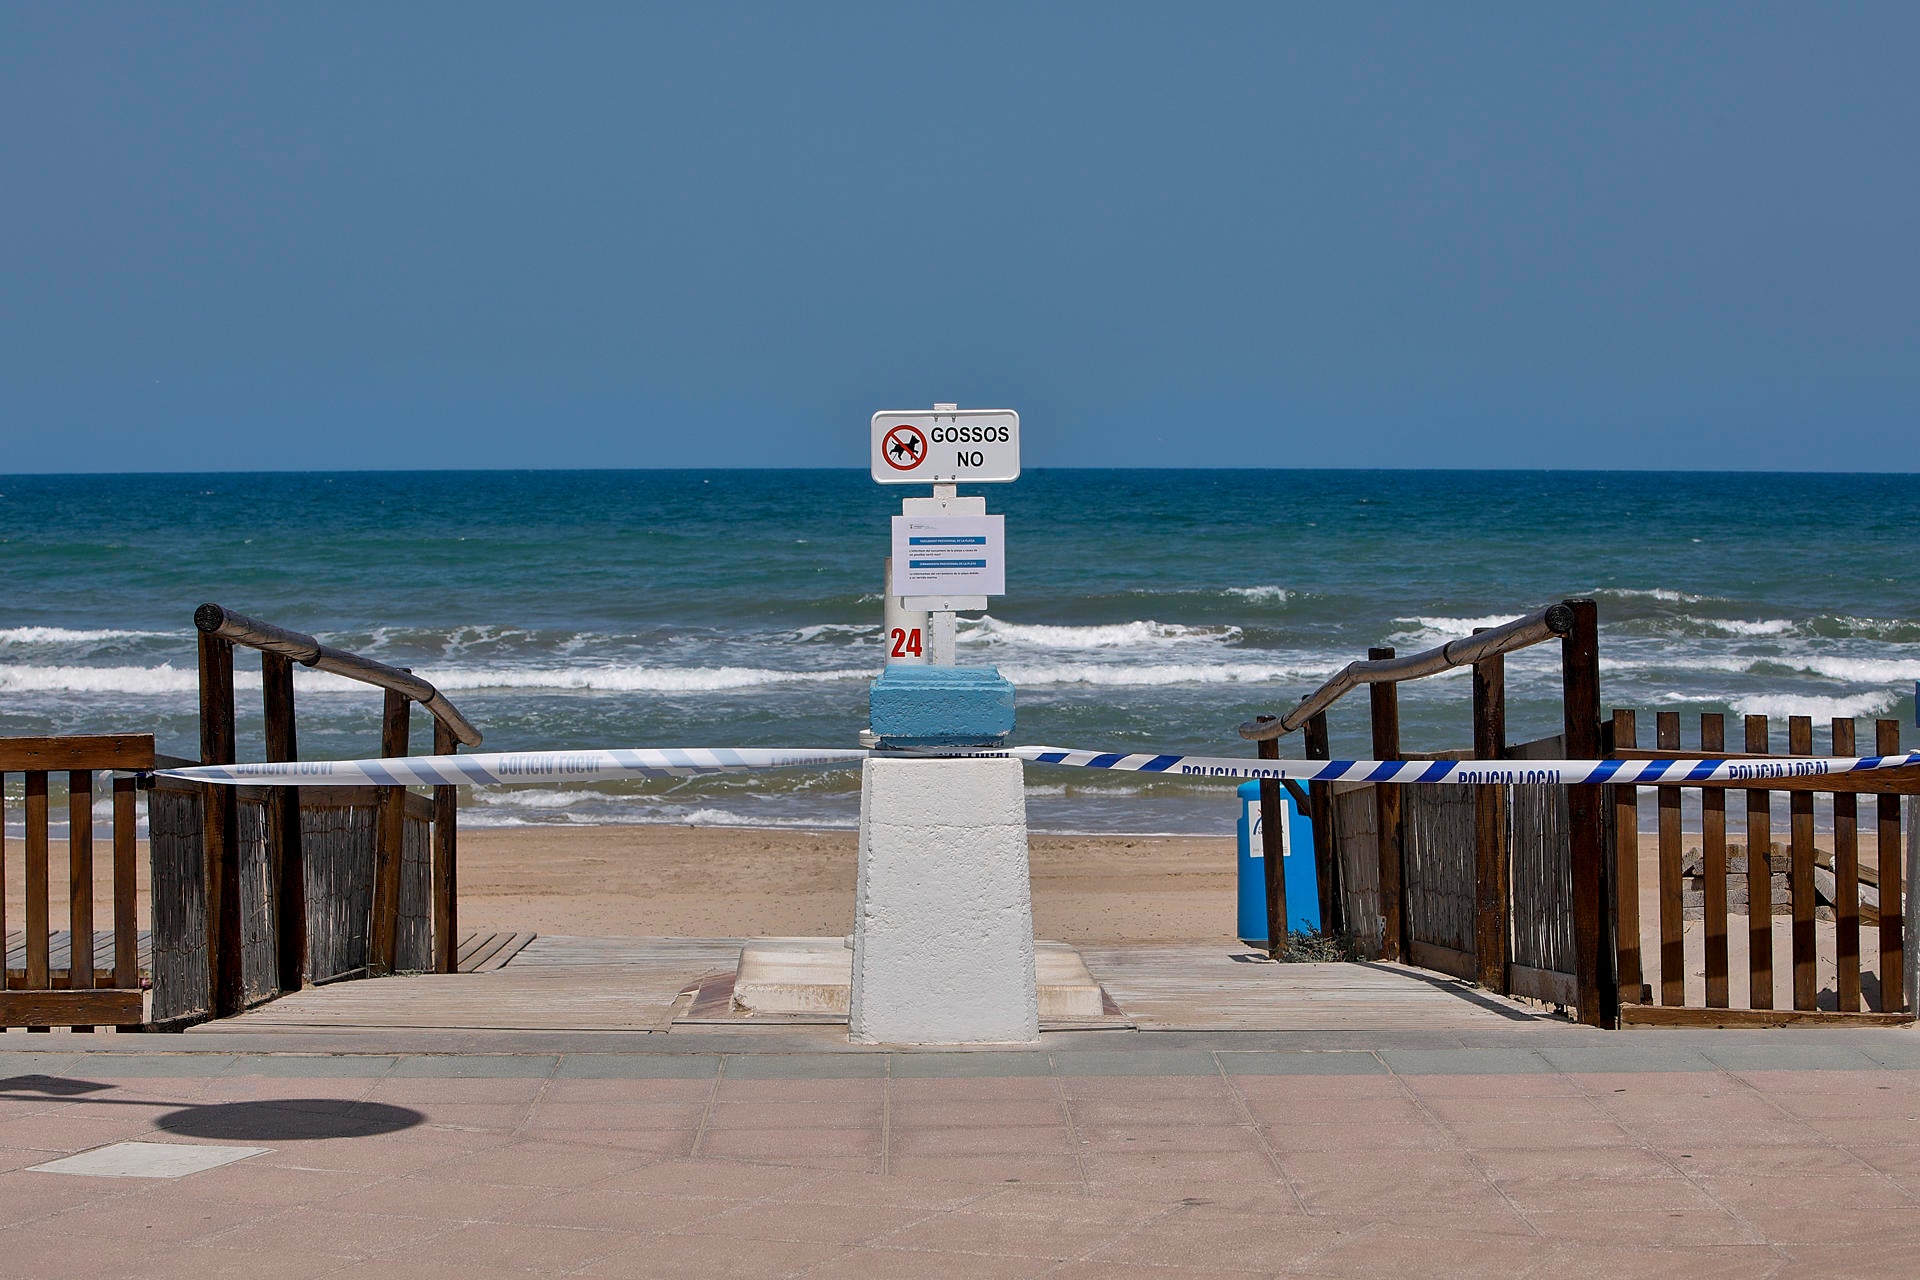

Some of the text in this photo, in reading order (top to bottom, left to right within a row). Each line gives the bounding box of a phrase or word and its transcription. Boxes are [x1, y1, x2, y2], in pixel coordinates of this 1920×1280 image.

[931, 427, 1009, 442] GOSSOS
[957, 452, 984, 467] NO
[890, 628, 922, 657] 24
[1458, 770, 1560, 784] POLICIA LOCAL
[1728, 761, 1829, 780] POLICIA LOCAL
